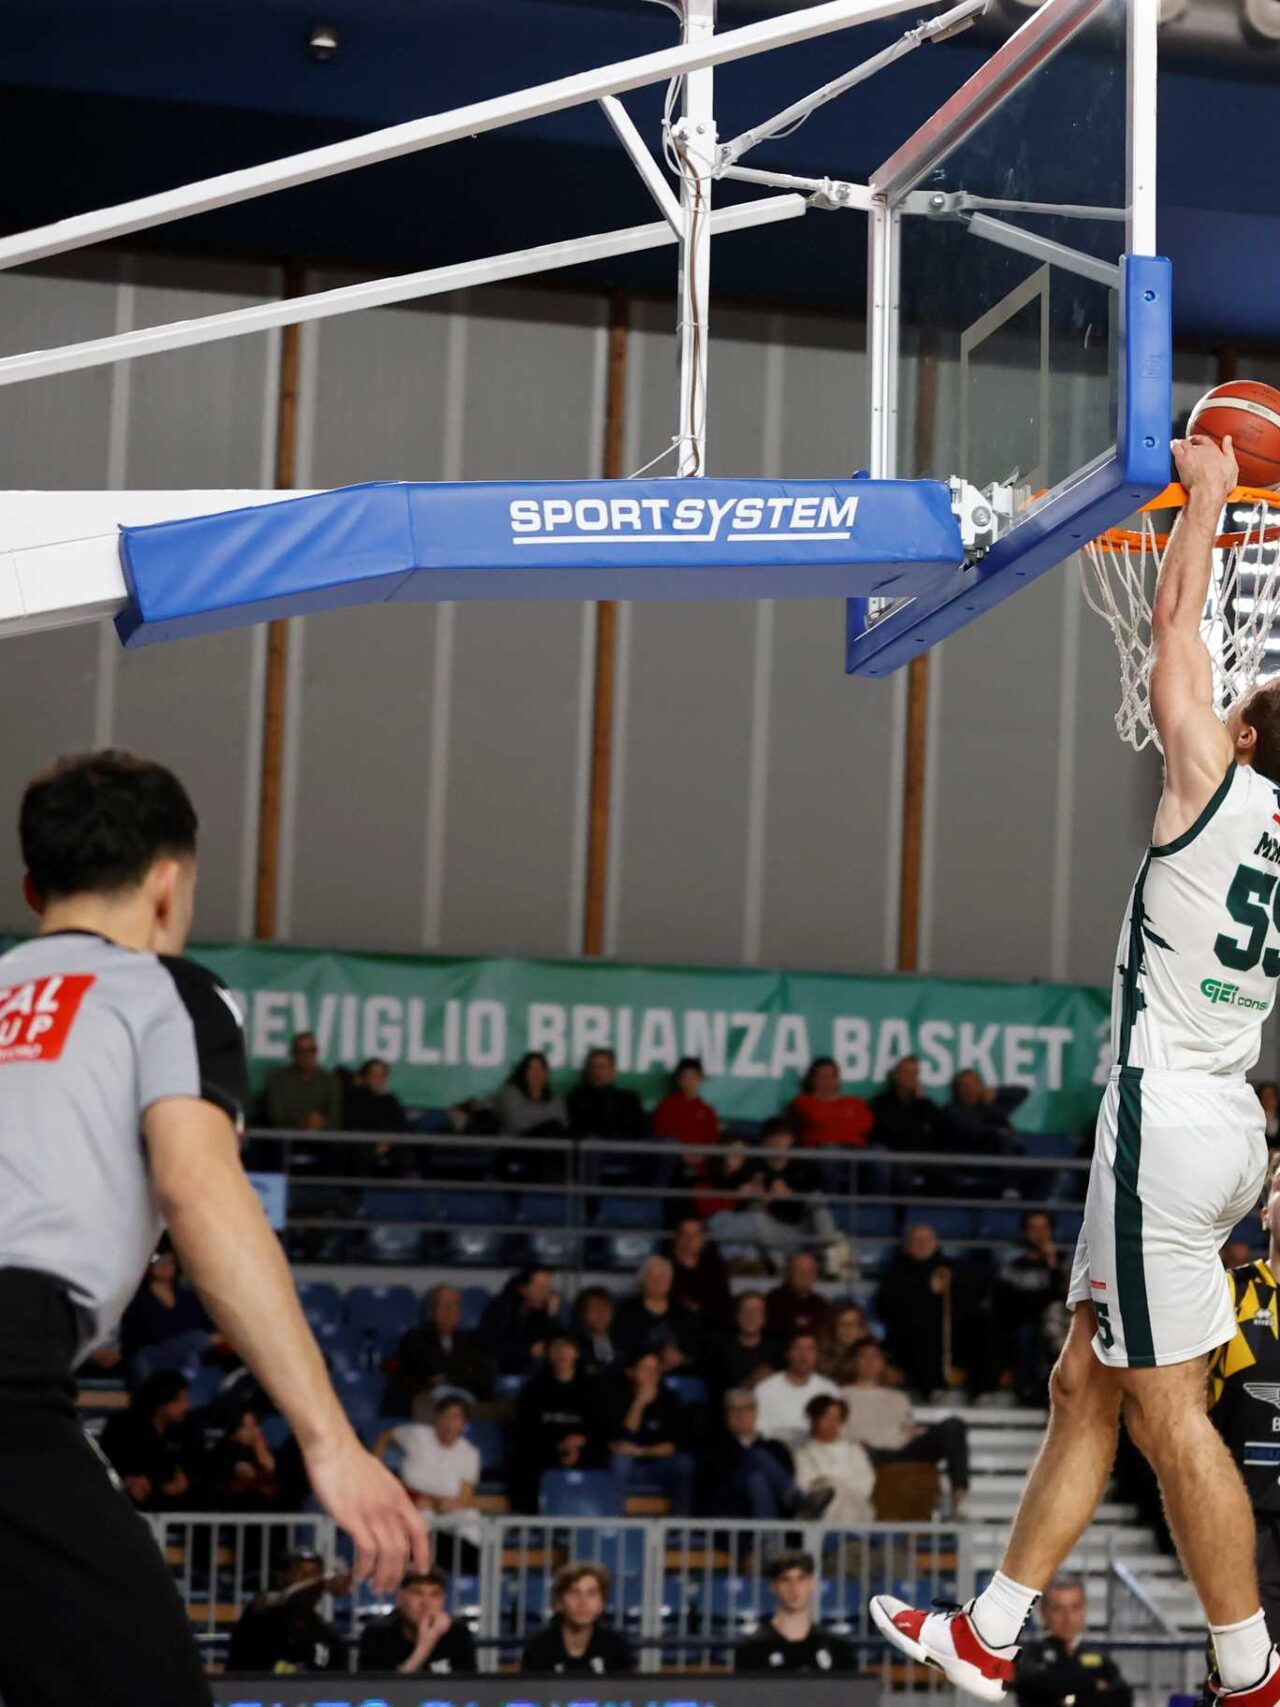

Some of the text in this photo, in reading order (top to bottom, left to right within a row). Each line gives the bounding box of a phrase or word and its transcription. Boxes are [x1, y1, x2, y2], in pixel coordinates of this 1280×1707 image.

[237, 991, 509, 1068] EVIGLIO
[528, 1003, 812, 1079] BRIANZA
[834, 1016, 1074, 1091] BASKET
